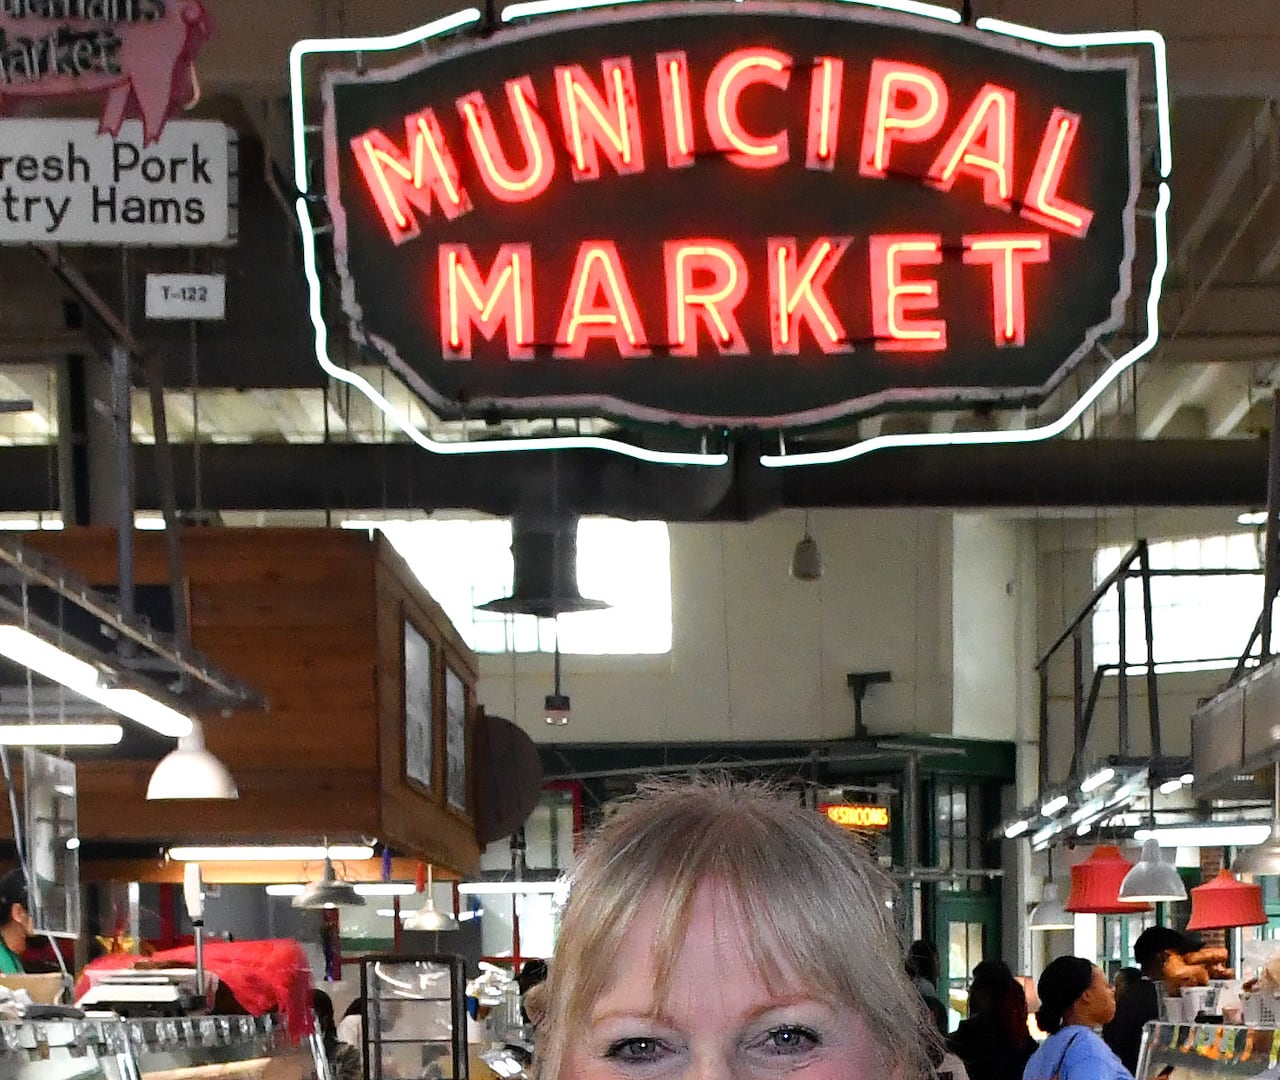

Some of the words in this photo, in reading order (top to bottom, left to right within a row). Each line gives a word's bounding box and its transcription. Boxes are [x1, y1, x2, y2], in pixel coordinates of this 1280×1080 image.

[114, 142, 212, 185] Pork
[350, 47, 1095, 245] MUNICIPAL
[92, 187, 205, 225] Hams
[438, 234, 1050, 361] MARKET
